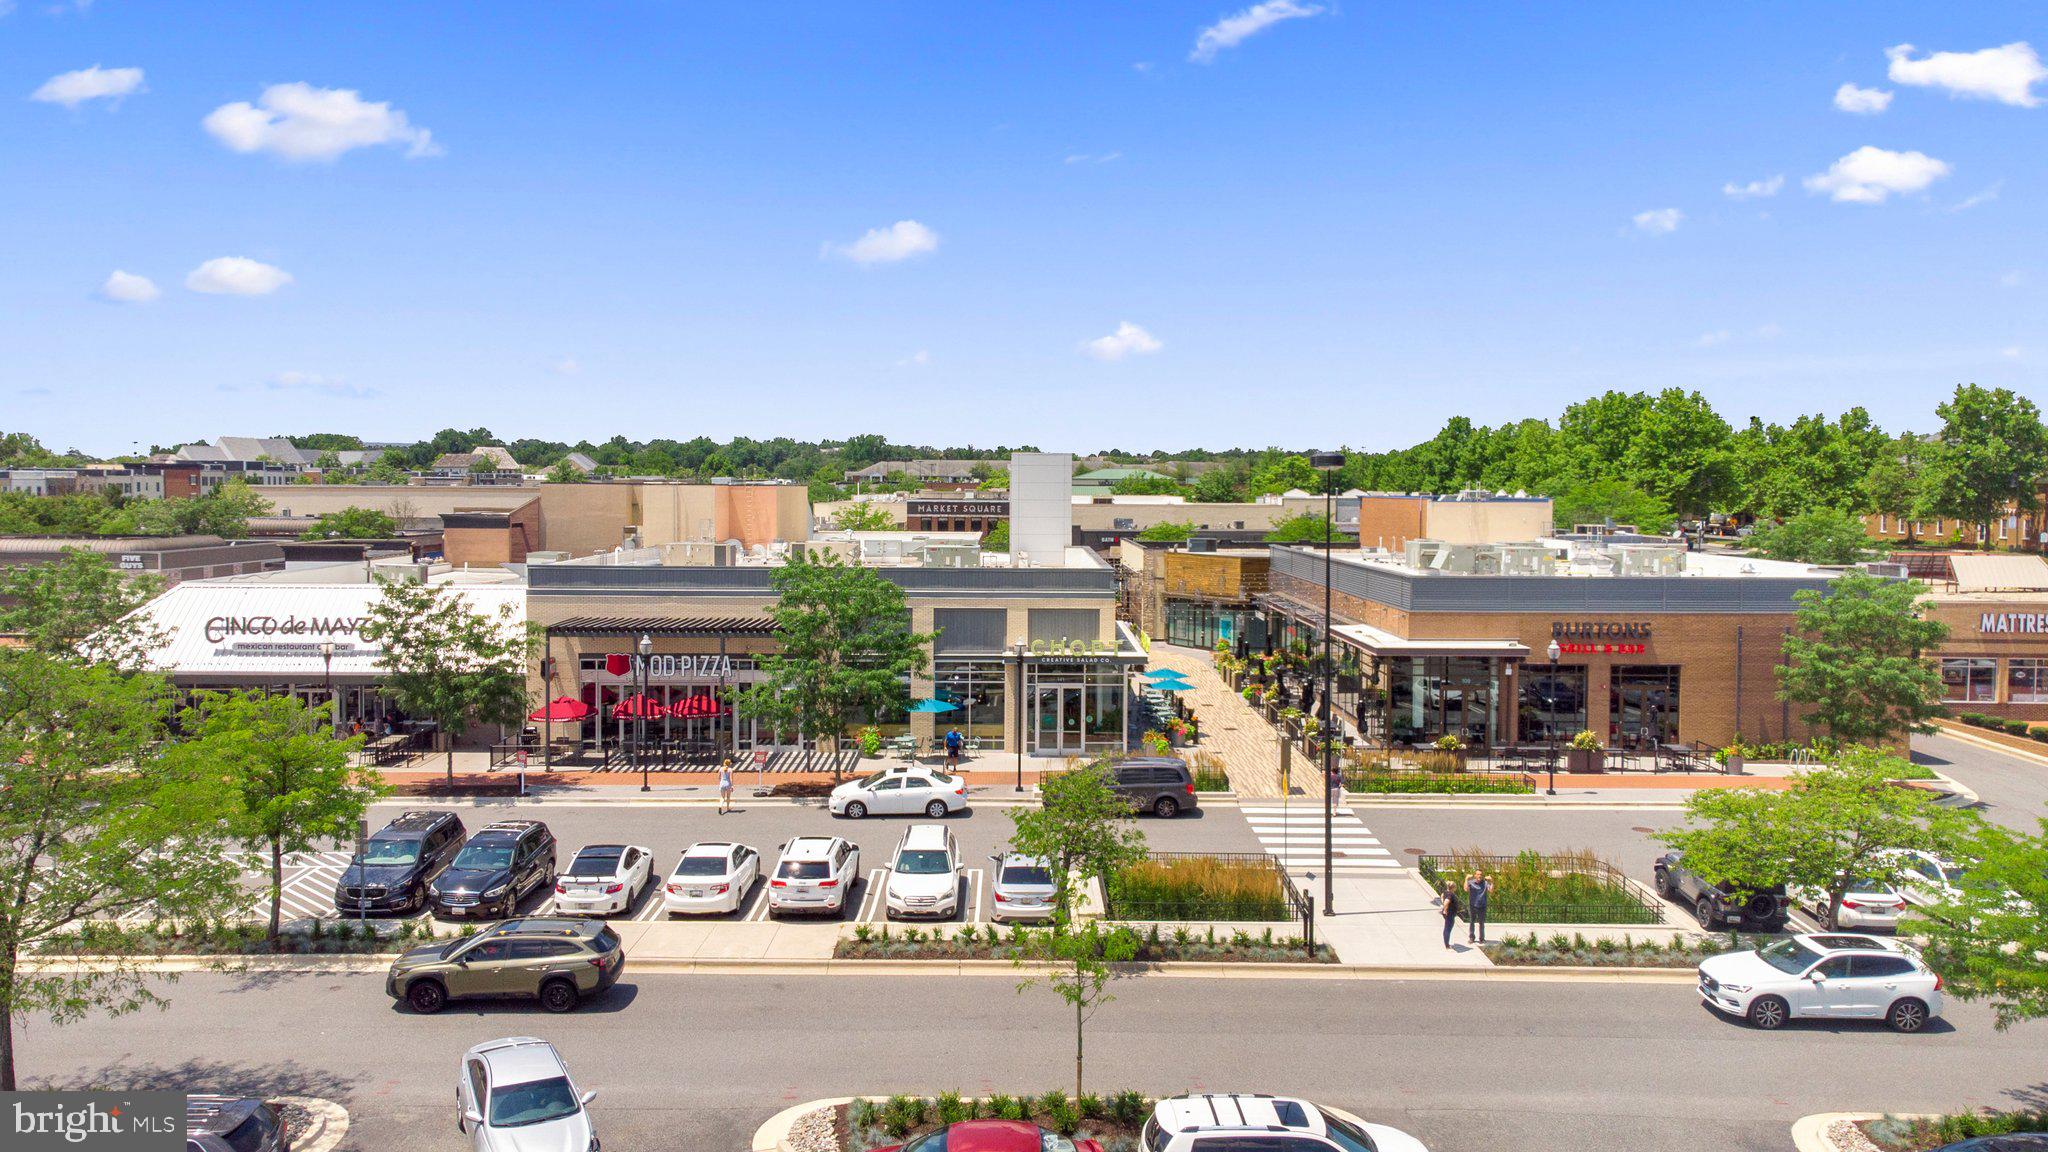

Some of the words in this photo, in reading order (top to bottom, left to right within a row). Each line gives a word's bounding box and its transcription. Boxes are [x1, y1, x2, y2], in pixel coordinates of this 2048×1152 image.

[917, 505, 957, 513] MARKET
[963, 505, 1002, 513] SQUARE
[205, 616, 277, 643] CINCO
[280, 615, 306, 634] de
[1552, 622, 1652, 639] BURTONS
[1031, 639, 1123, 656] CHOPT
[636, 655, 675, 676] MOD
[681, 655, 732, 676] PIZZA
